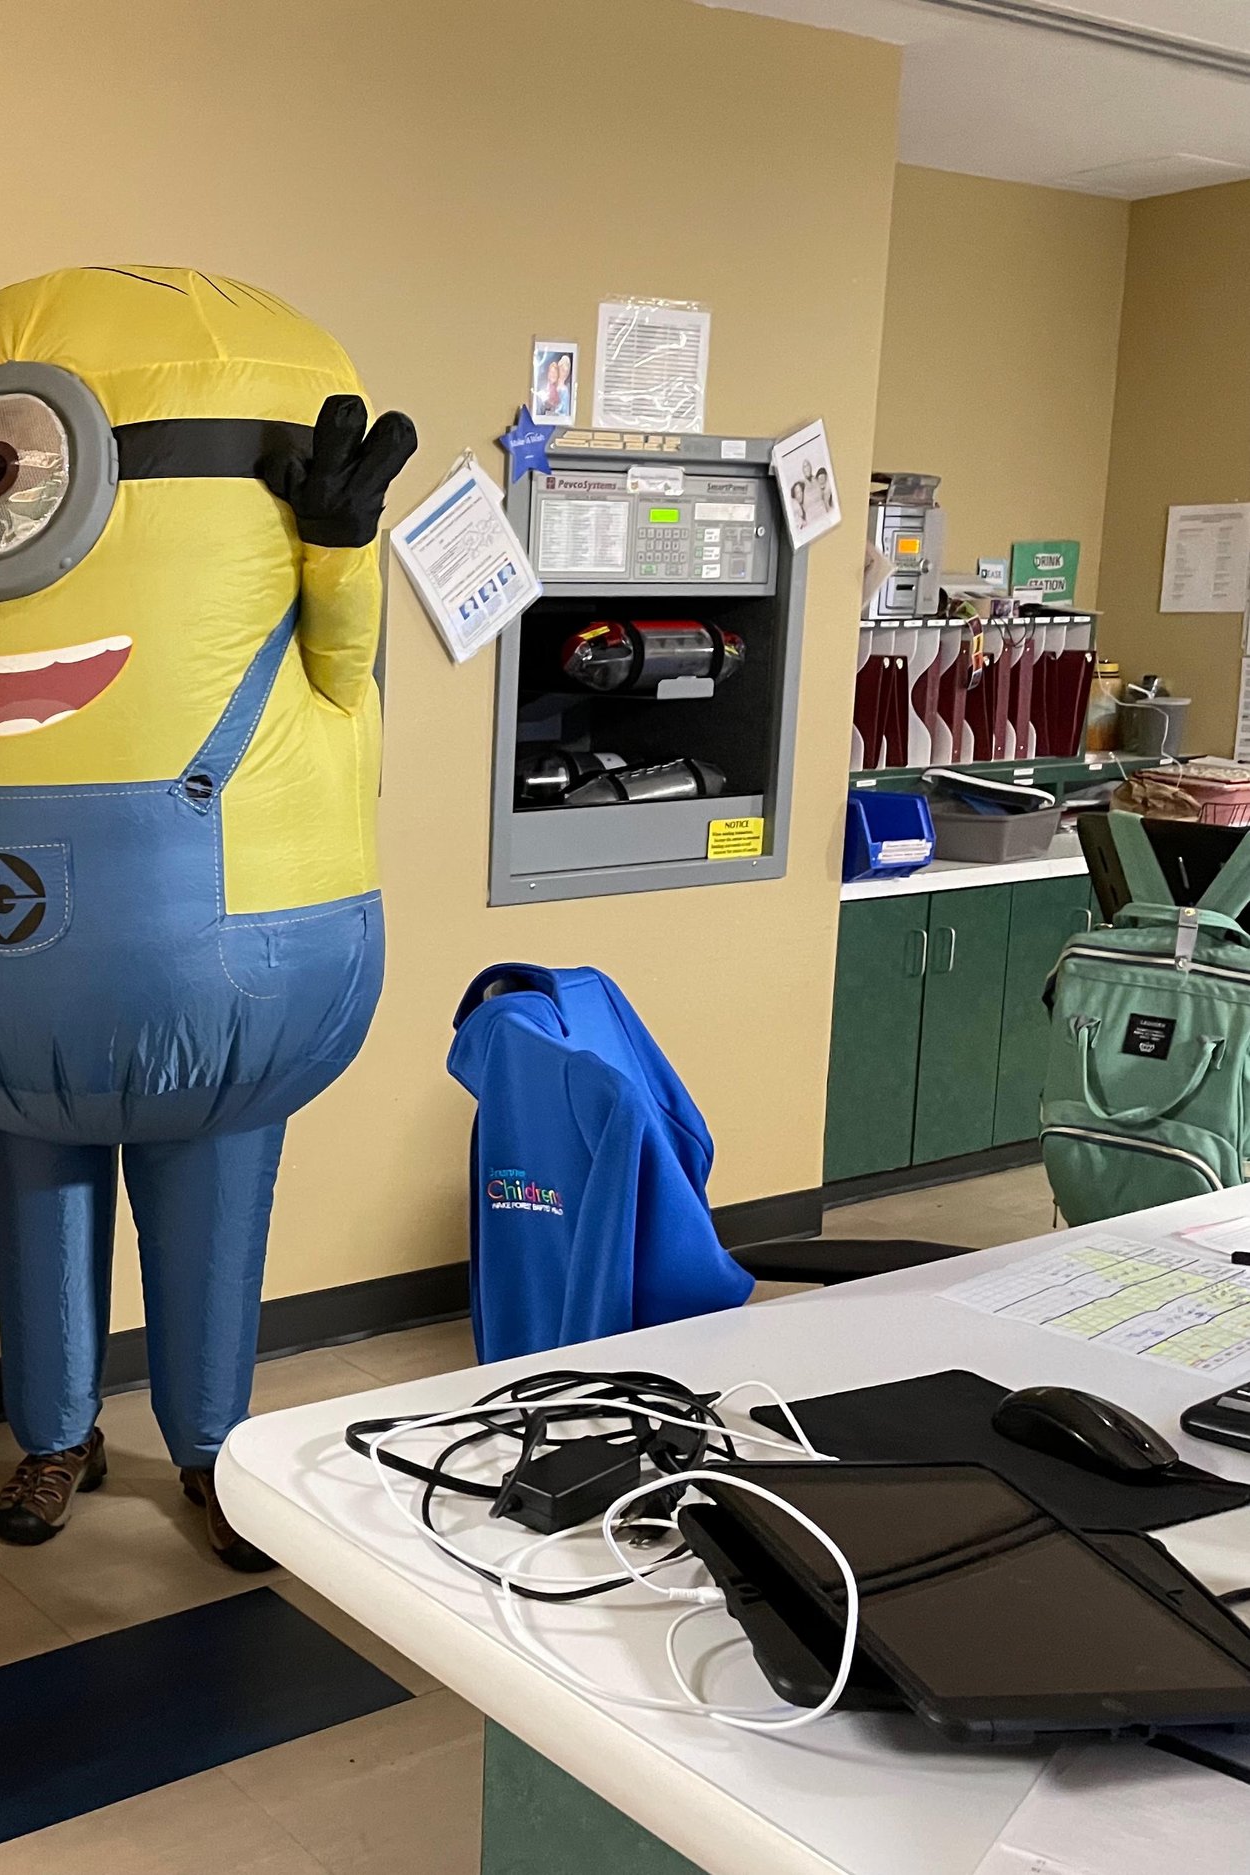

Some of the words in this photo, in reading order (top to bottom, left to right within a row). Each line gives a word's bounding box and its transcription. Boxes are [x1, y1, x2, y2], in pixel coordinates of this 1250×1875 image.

[557, 479, 617, 491] PevcoSystems
[1035, 555, 1062, 567] DRINK
[724, 820, 749, 829] NOTICE
